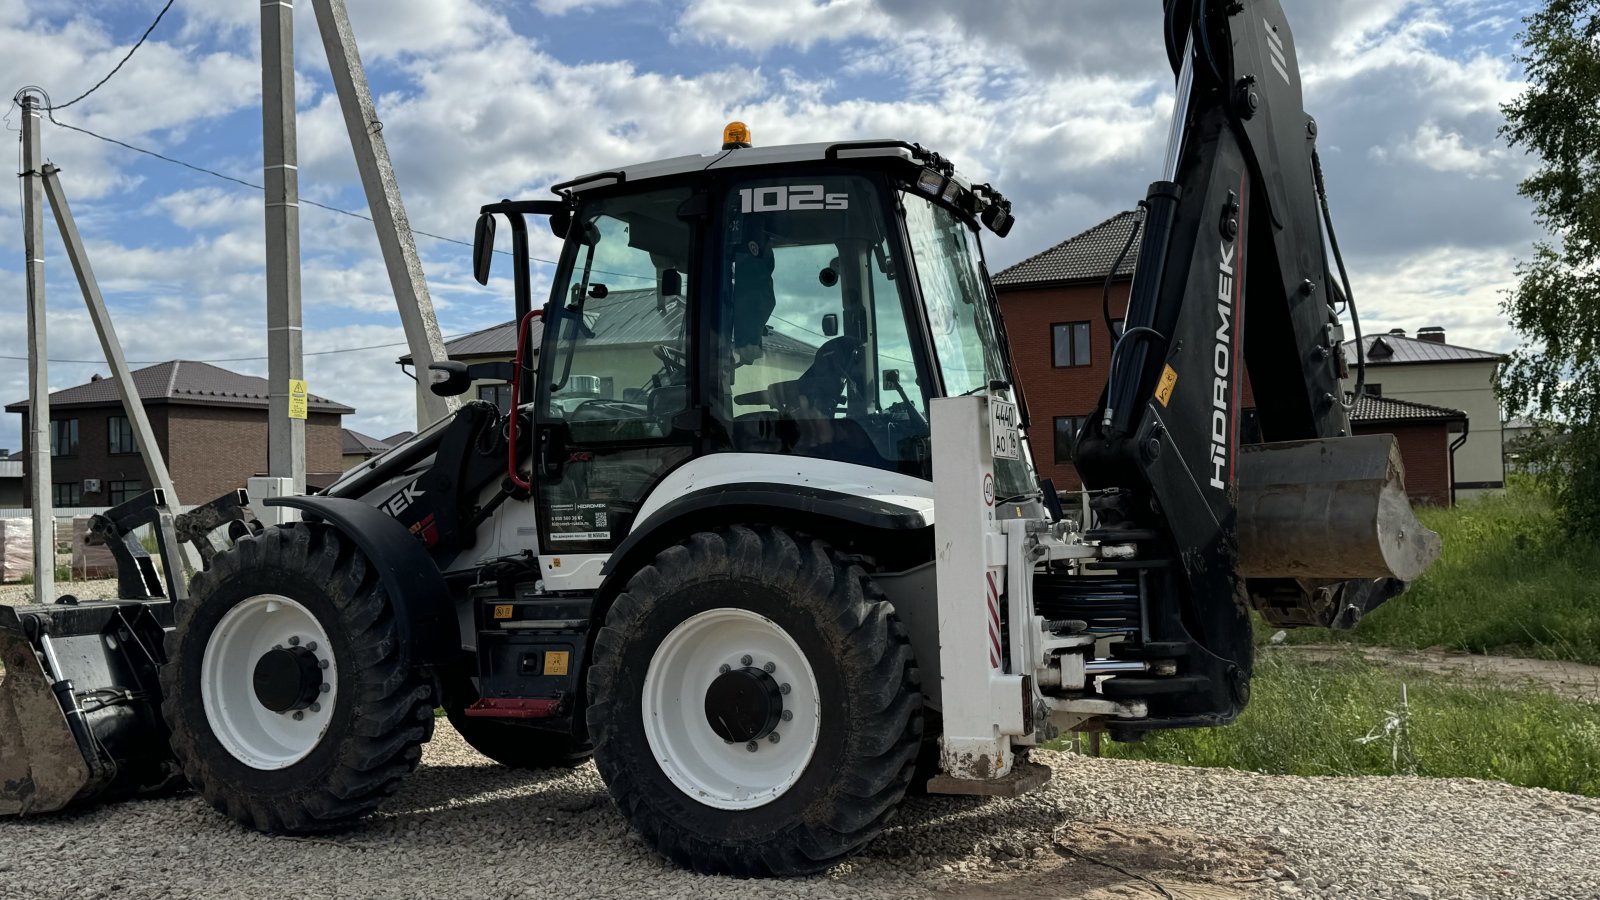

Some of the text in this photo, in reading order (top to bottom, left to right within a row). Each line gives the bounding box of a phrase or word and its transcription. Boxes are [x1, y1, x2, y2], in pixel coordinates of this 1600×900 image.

[995, 404, 1014, 428] 4440
[1009, 432, 1017, 448] 16
[985, 482, 992, 497] 40
